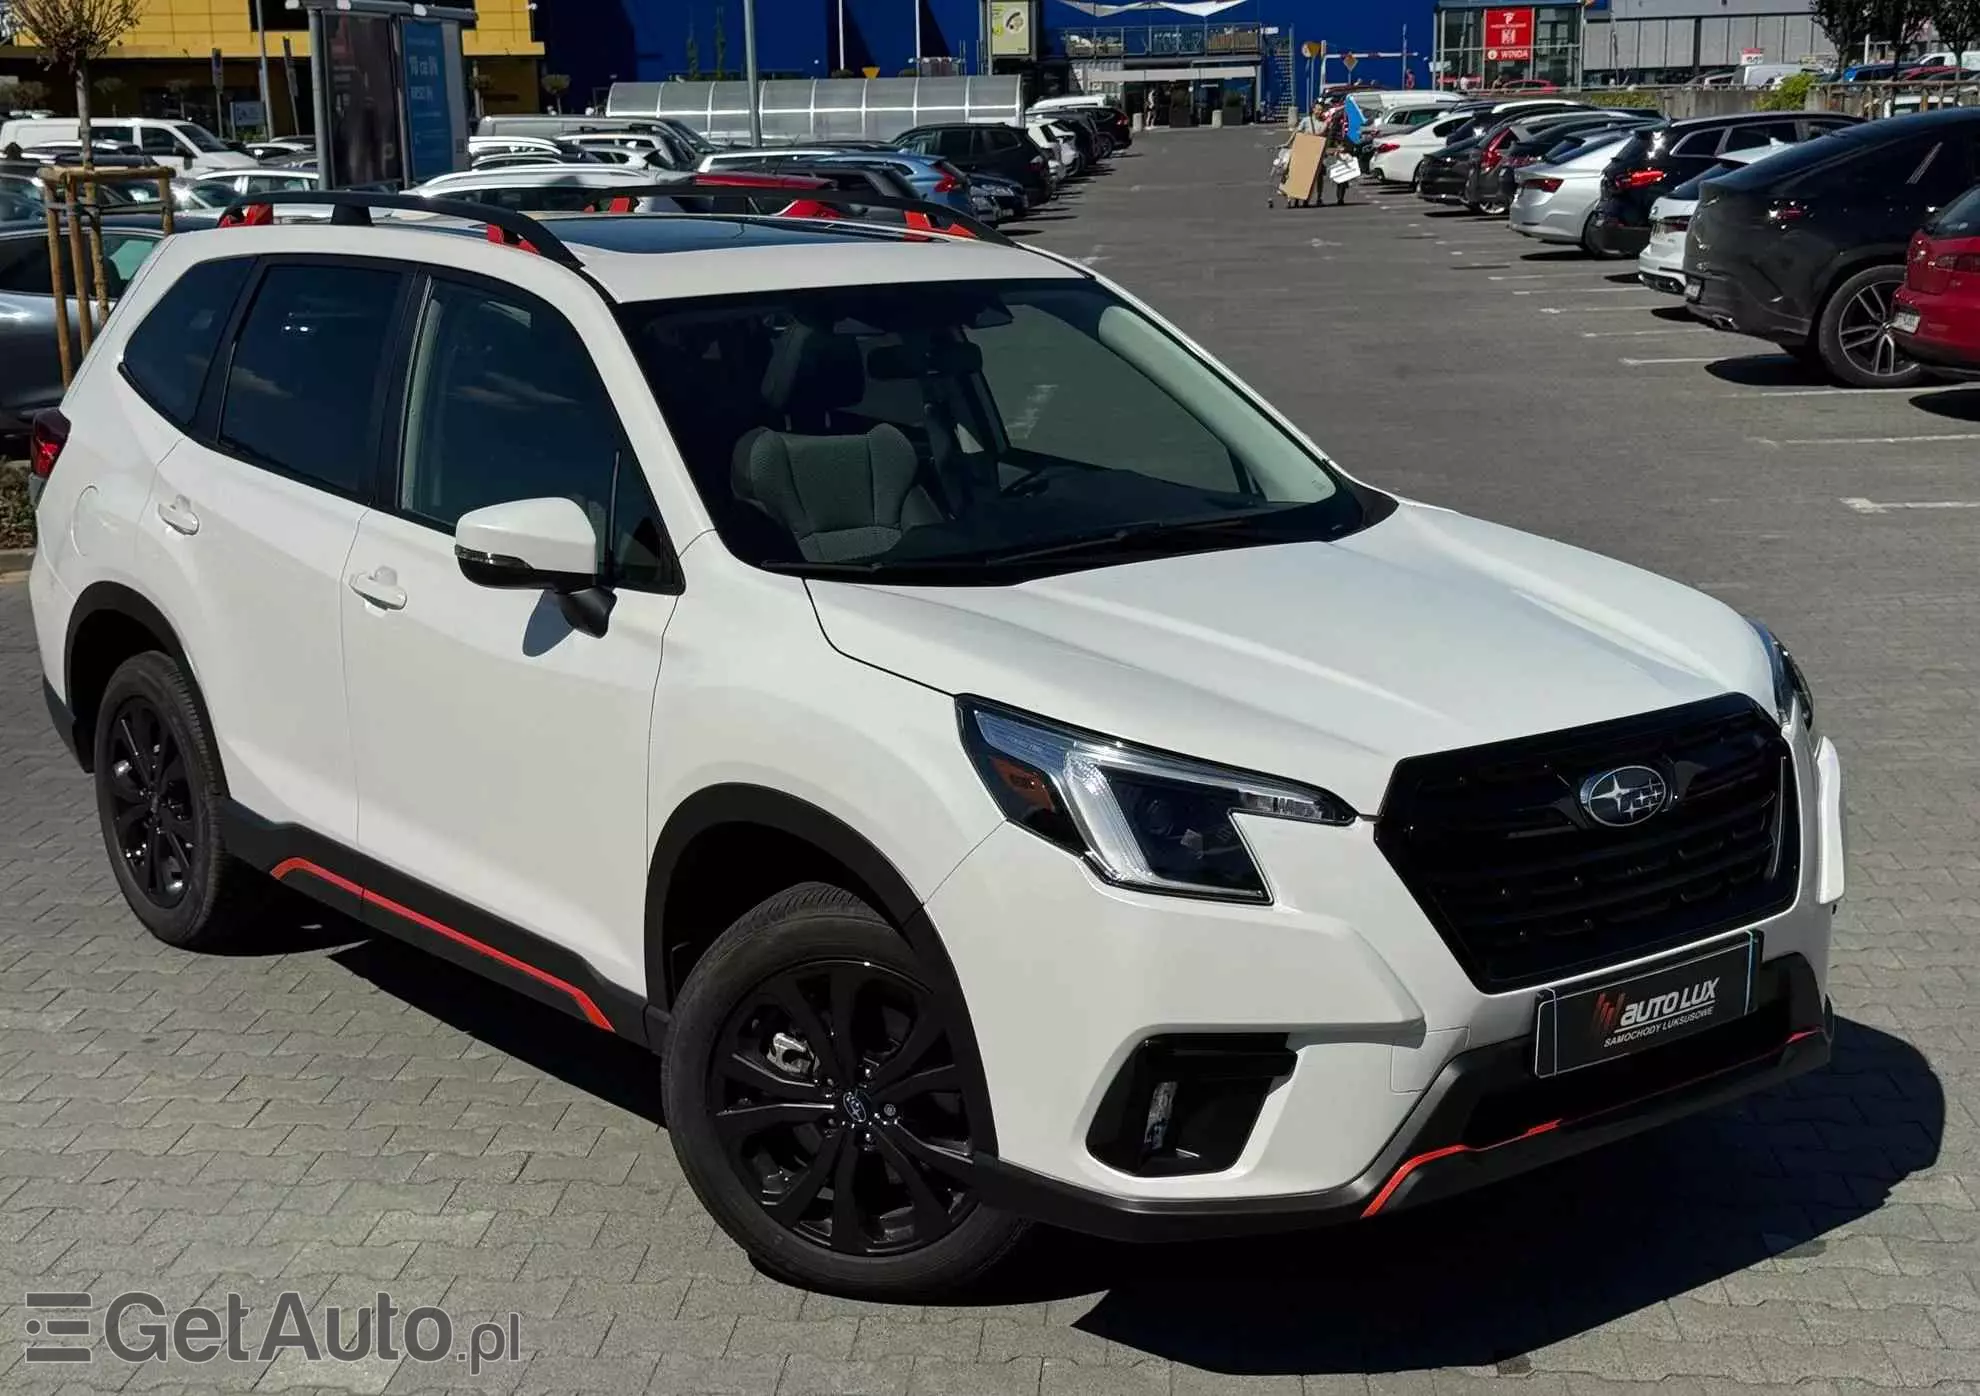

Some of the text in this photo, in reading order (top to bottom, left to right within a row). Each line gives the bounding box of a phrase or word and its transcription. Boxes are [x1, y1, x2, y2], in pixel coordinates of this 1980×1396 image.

[1680, 976, 1720, 1009] LUX
[1603, 1006, 1714, 1048] SAMOCHODY LUKSUSOWE
